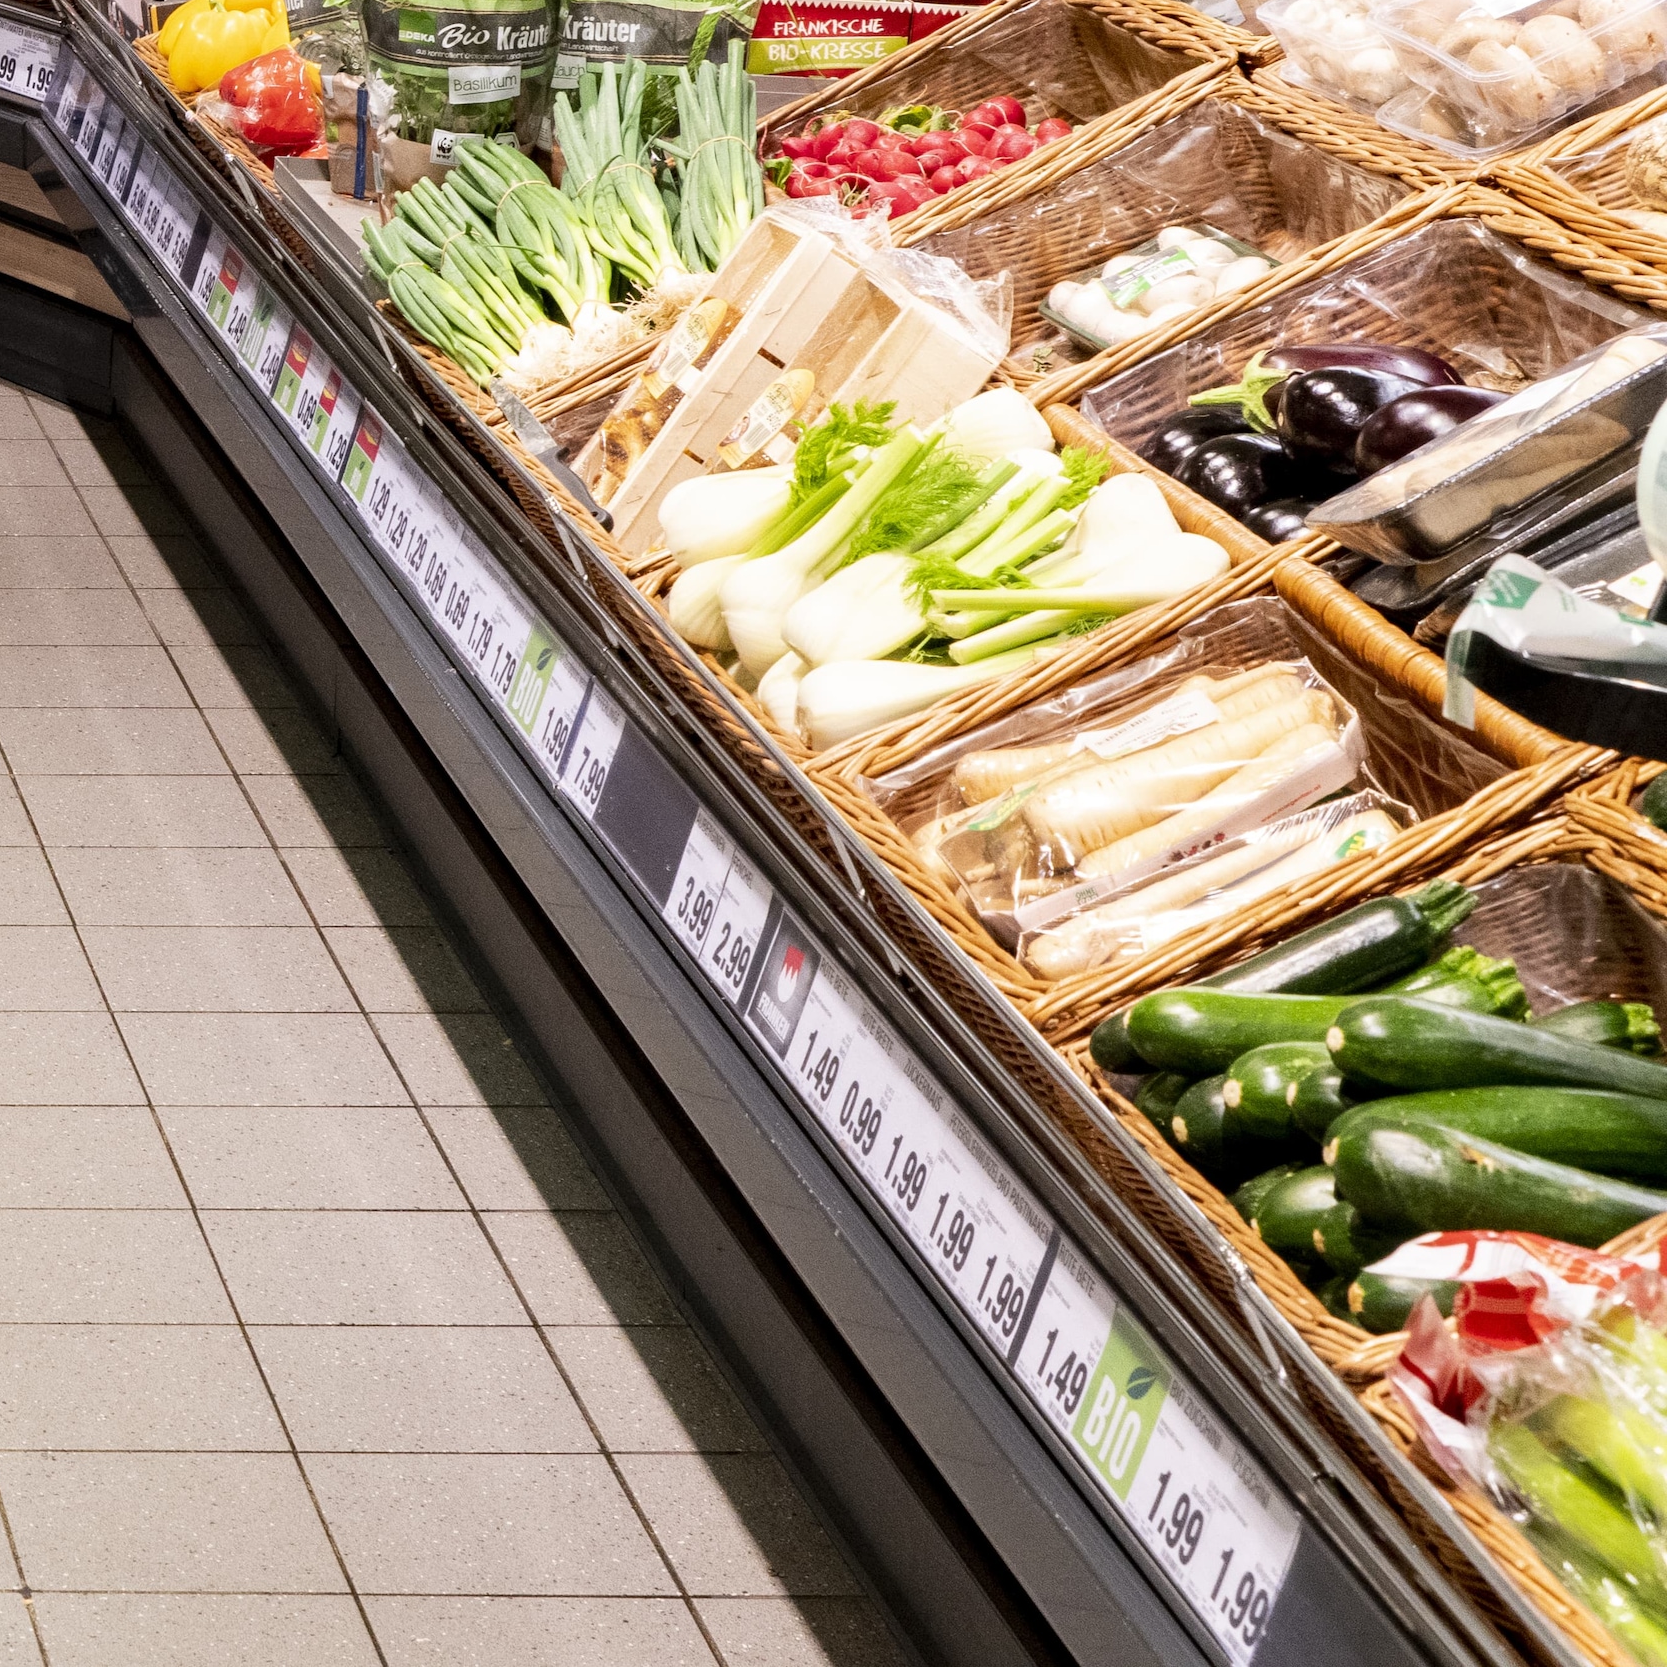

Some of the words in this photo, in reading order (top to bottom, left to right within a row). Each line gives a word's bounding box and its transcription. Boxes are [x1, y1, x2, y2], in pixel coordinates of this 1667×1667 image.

[399, 29, 436, 43] EDEKA
[437, 22, 491, 50] Bio
[562, 14, 641, 43] Kräuter
[768, 41, 888, 61] BIO-KRESSE
[773, 16, 885, 37] FRÄNKISCHE
[453, 71, 517, 93] Basilikum
[298, 390, 317, 429] 0.69
[328, 426, 347, 470] 1.29
[369, 478, 390, 520] 1.29
[386, 498, 408, 543] 1.29
[405, 528, 427, 572] 1.29
[425, 552, 447, 603] 0.69
[445, 582, 470, 630] 0.69
[468, 612, 493, 660] 1.79
[491, 644, 516, 694] 1.79
[509, 654, 544, 721] BIO
[543, 708, 568, 761] 1.99
[574, 743, 607, 807] 7.99
[678, 877, 713, 941] 3.99
[713, 922, 750, 988] 2.99
[757, 988, 789, 1044] FRANKEN
[801, 1031, 839, 1101] 1.49
[840, 1081, 881, 1155] 0.99
[885, 1136, 926, 1211] 1.99
[930, 1193, 974, 1271] 1.99
[978, 1256, 1024, 1337] 1.99
[1038, 1329, 1087, 1415] 1.49
[1082, 1376, 1140, 1484] BIO
[1149, 1472, 1203, 1565] 1.99
[1212, 1546, 1270, 1647] 1.99
